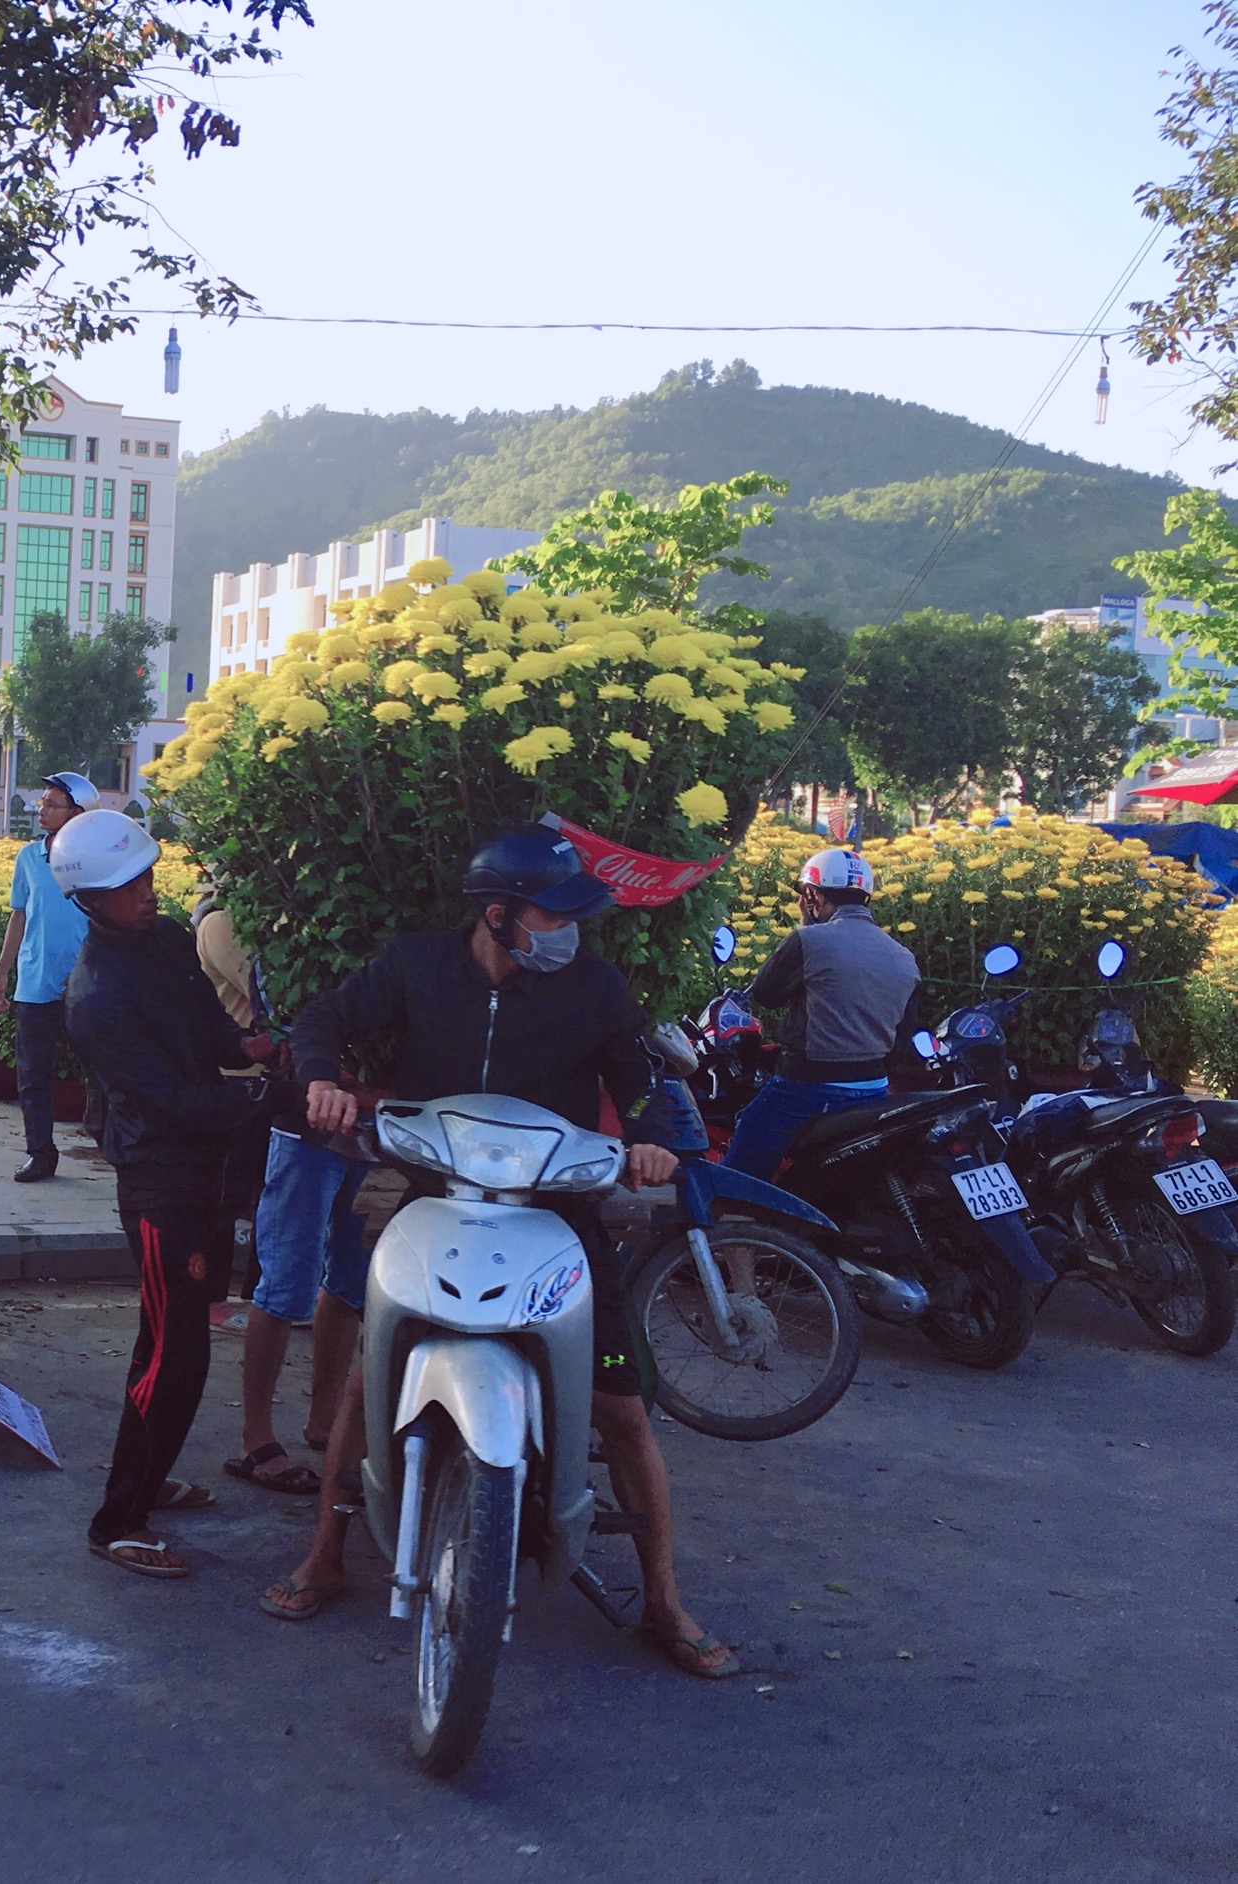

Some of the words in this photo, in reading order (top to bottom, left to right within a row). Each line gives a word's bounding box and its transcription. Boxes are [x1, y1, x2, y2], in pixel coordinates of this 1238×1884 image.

[1103, 597, 1135, 607] MALLOCA
[961, 1166, 1006, 1194] 77-L1
[1164, 1164, 1215, 1191] 77-L1
[967, 1186, 1023, 1216] 283.83
[1172, 1181, 1233, 1210] 686.88
